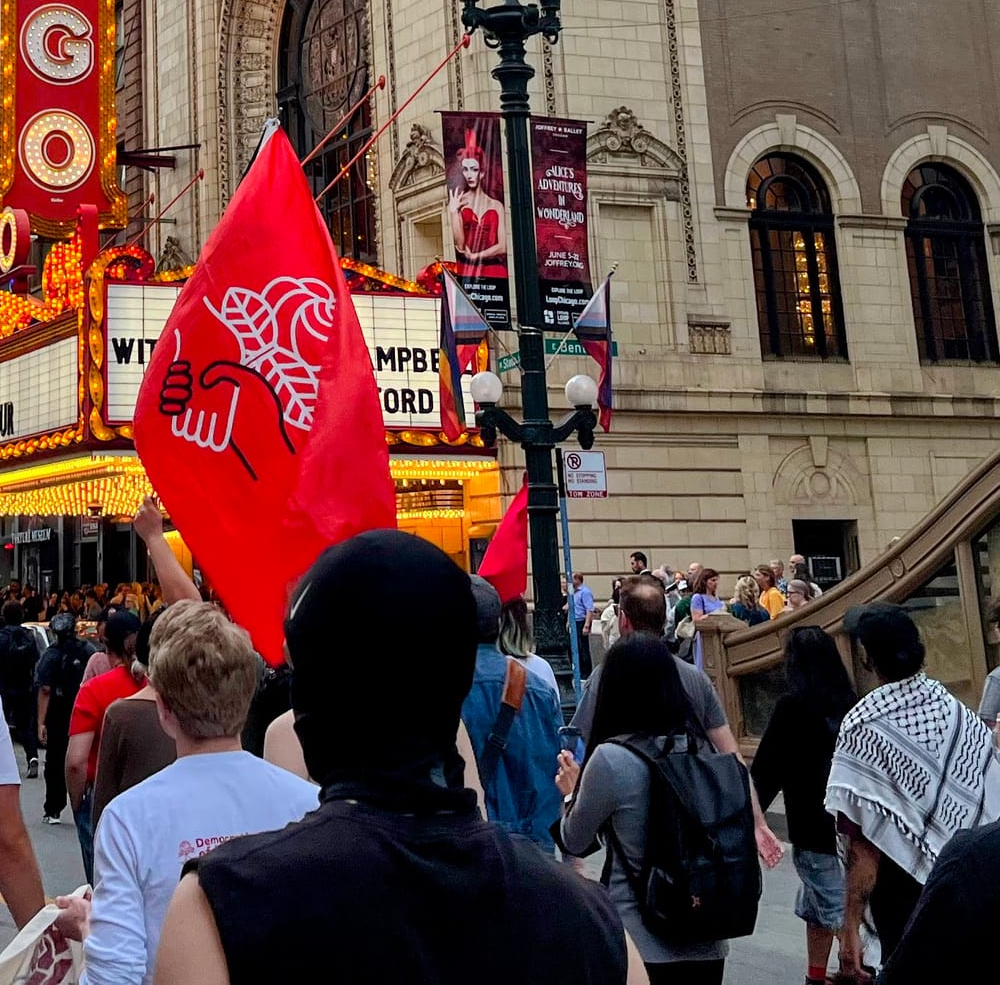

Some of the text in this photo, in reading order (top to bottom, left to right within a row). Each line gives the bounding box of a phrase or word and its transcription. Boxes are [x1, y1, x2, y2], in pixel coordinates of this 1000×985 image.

[546, 166, 575, 179] ALICE'S
[537, 179, 584, 200] ADVENTURES
[558, 195, 566, 206] IN
[537, 207, 584, 227] WONDERLAND
[548, 251, 566, 259] JUNE
[467, 293, 504, 303] Chicago.com
[377, 387, 434, 414] ORD
